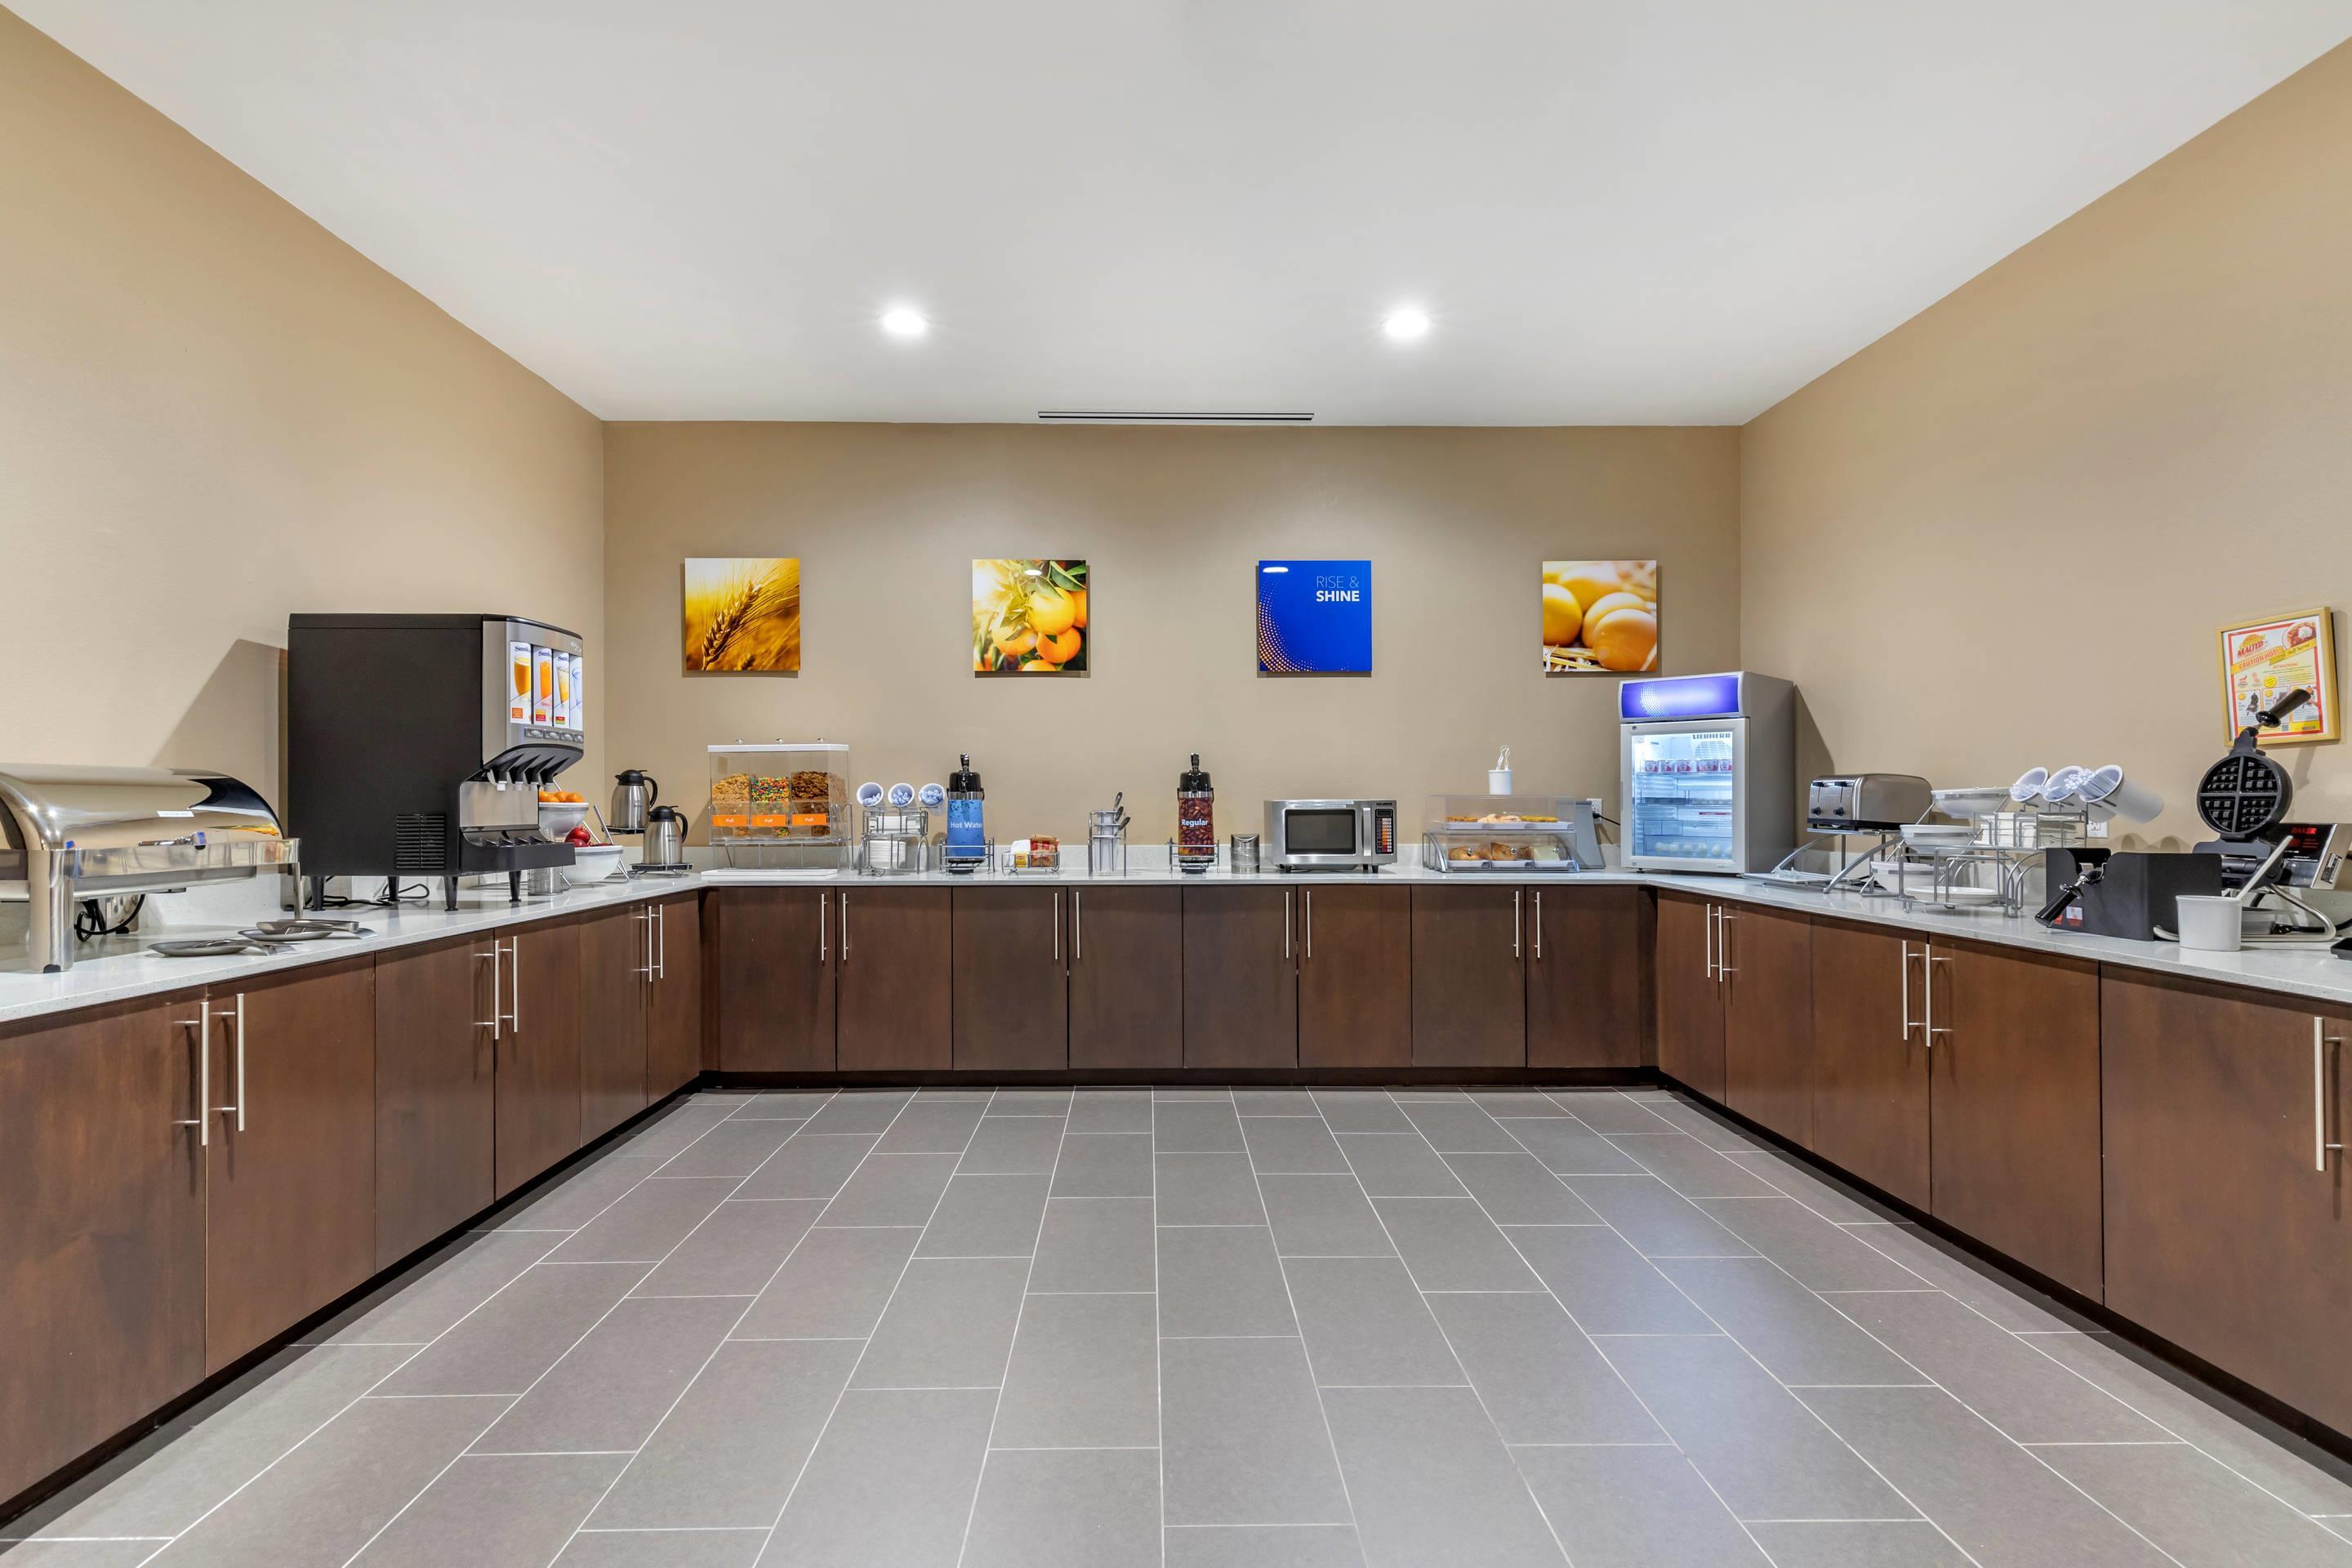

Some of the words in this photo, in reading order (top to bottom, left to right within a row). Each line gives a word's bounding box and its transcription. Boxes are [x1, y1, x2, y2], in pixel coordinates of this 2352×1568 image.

[1316, 576, 1344, 588] RISE
[1349, 575, 1359, 588] &
[1316, 590, 1360, 602] SHINE
[2239, 654, 2264, 670] CAUTION
[1181, 818, 1208, 827] Regular
